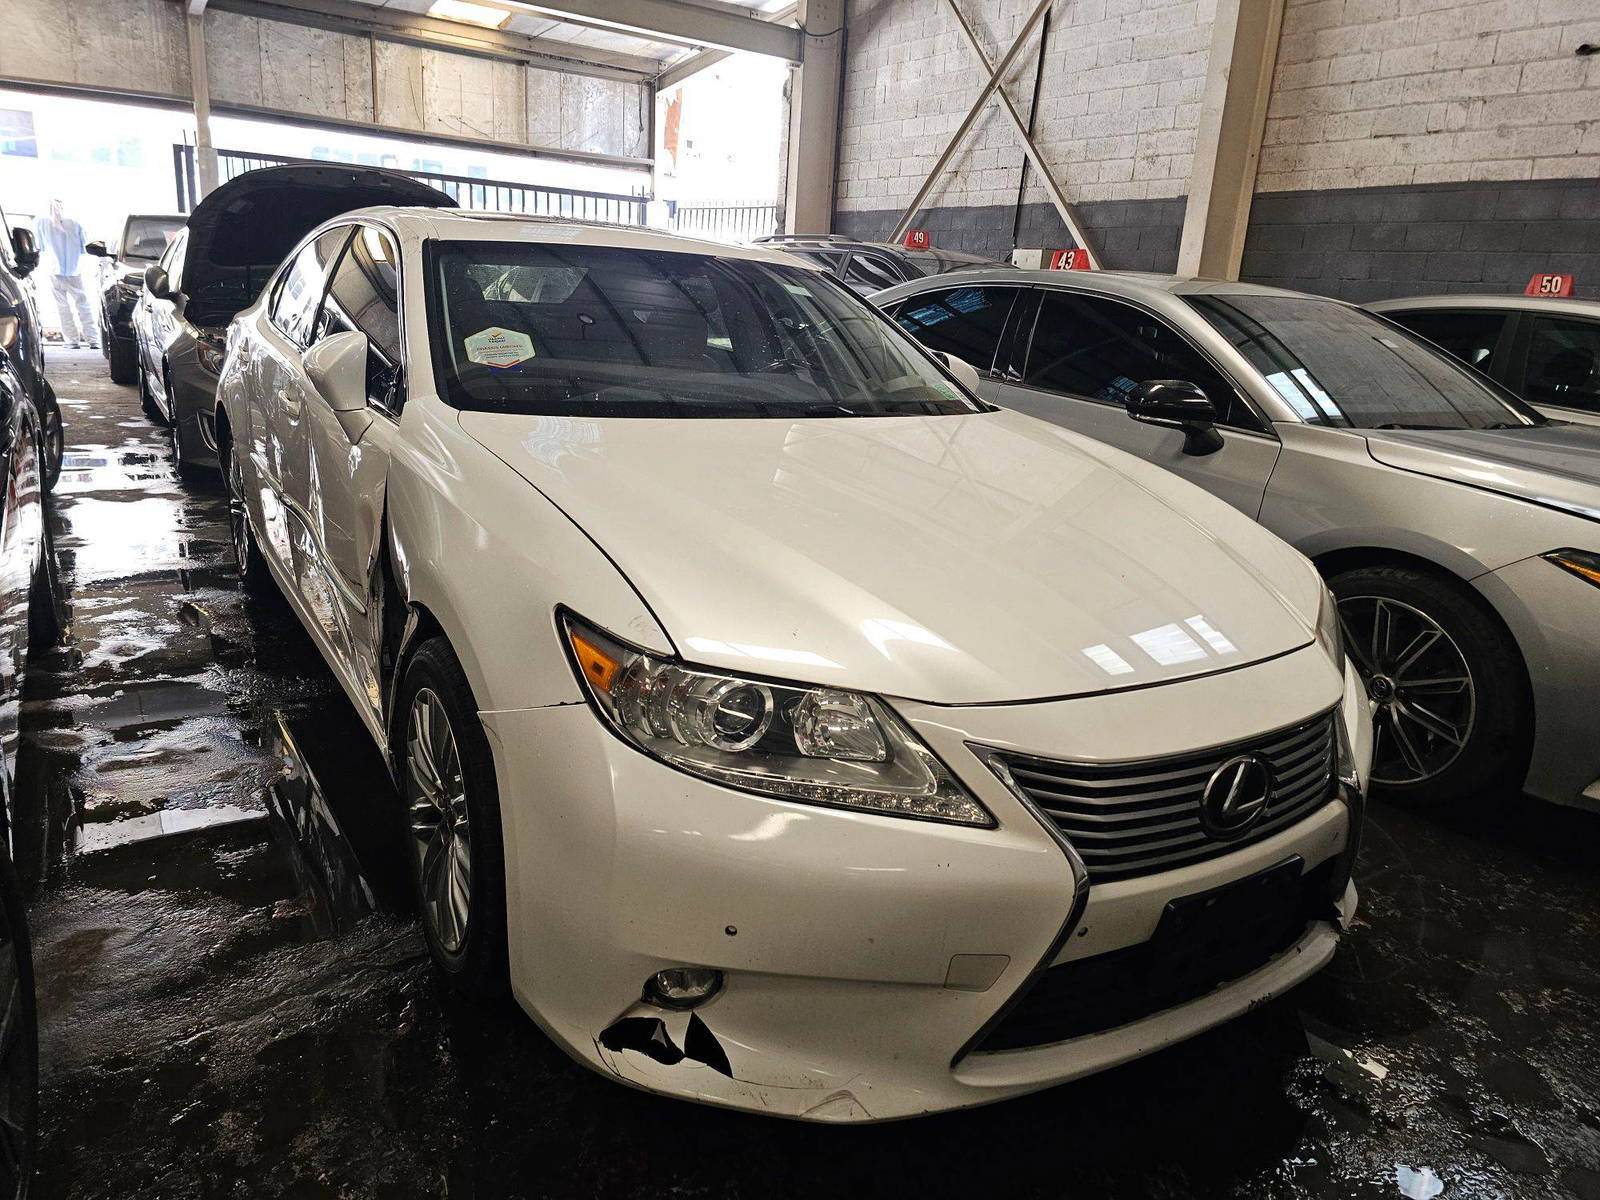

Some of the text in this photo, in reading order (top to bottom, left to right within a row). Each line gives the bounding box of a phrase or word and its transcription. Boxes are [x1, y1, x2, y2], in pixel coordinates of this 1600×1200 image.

[913, 231, 924, 244] 49
[1057, 251, 1075, 270] 43
[1540, 275, 1562, 293] 50
